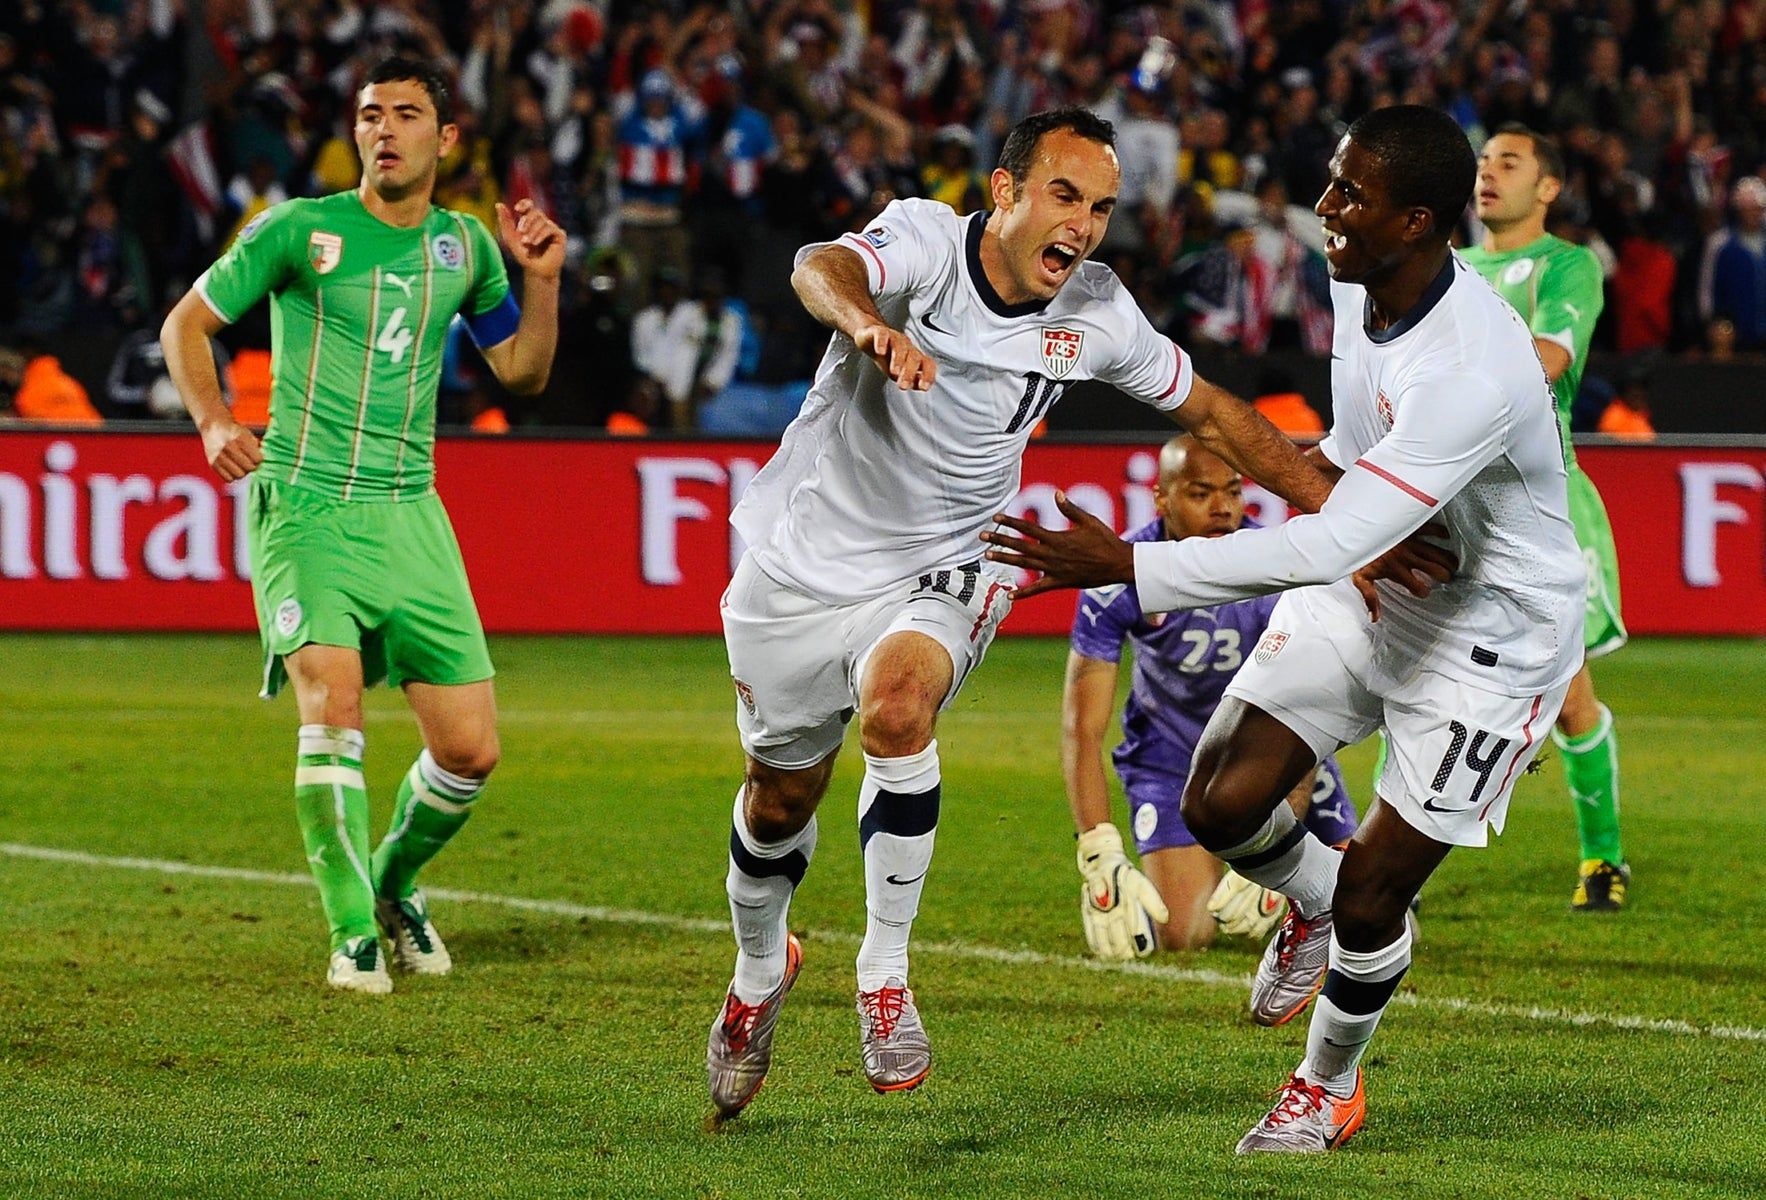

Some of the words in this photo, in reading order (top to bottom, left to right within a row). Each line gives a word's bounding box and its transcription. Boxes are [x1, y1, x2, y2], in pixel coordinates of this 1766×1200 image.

[377, 306, 413, 363] 4
[1045, 341, 1077, 359] US
[1179, 628, 1242, 673] 23
[1430, 719, 1511, 802] 14
